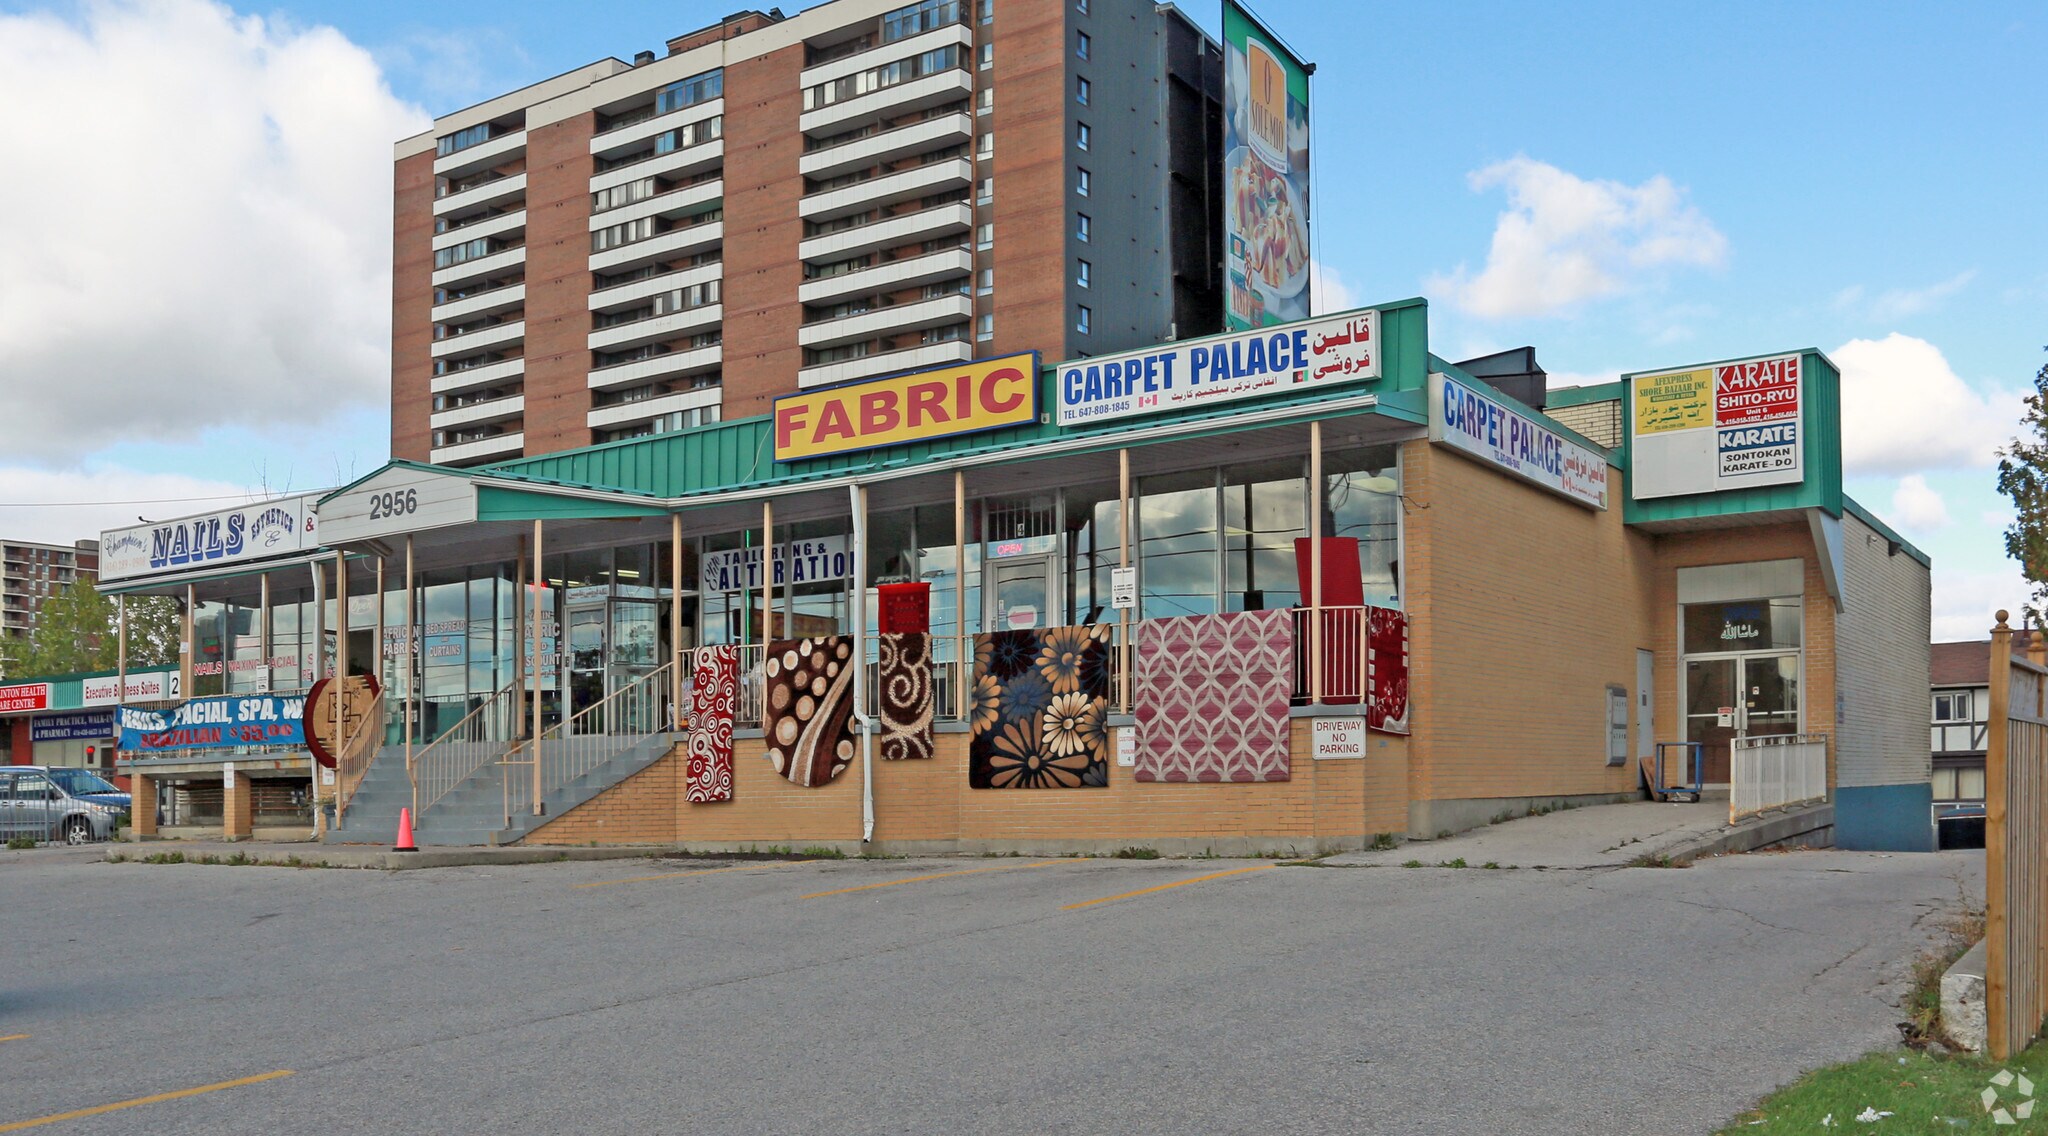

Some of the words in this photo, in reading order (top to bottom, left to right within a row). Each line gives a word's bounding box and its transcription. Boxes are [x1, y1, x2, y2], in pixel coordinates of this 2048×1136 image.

[1063, 352, 1177, 405] CARPET
[1190, 329, 1309, 385] PALACE
[1714, 357, 1797, 393] KARATE
[1639, 386, 1663, 398] SHORE
[1664, 383, 1693, 395] BAZAAR
[1694, 381, 1708, 390] INC.
[1720, 388, 1795, 409] SHITO-RYU
[777, 367, 1026, 449] FABRIC
[1063, 410, 1078, 420] TEL.
[1078, 400, 1130, 418] 647-808-1845
[1746, 408, 1761, 416] Unit
[1443, 381, 1505, 450] CARPET
[1511, 416, 1562, 477] PALACE
[1720, 424, 1795, 449] KARATE
[1726, 448, 1790, 462] SONTOKAN
[1723, 458, 1792, 473] KARATE-DO
[369, 488, 417, 520] 2956
[305, 516, 315, 533] &
[104, 530, 148, 558] Champion's
[150, 511, 246, 568] NAILS
[817, 542, 827, 554] &
[997, 543, 1023, 556] OPEN
[429, 643, 461, 657] CURTAINS
[193, 660, 223, 676] NAILS
[21, 685, 46, 697] HEALTH
[86, 685, 113, 700] Executive
[141, 681, 160, 695] Suites
[12, 698, 36, 710] CENTRE
[238, 698, 277, 721] SPA,
[40, 728, 72, 739] PHARMACY
[1316, 720, 1362, 732] DRIVEWAY
[141, 727, 222, 749] BRAZILIAN
[1331, 732, 1347, 743] NO
[1319, 743, 1359, 754] PARKING
